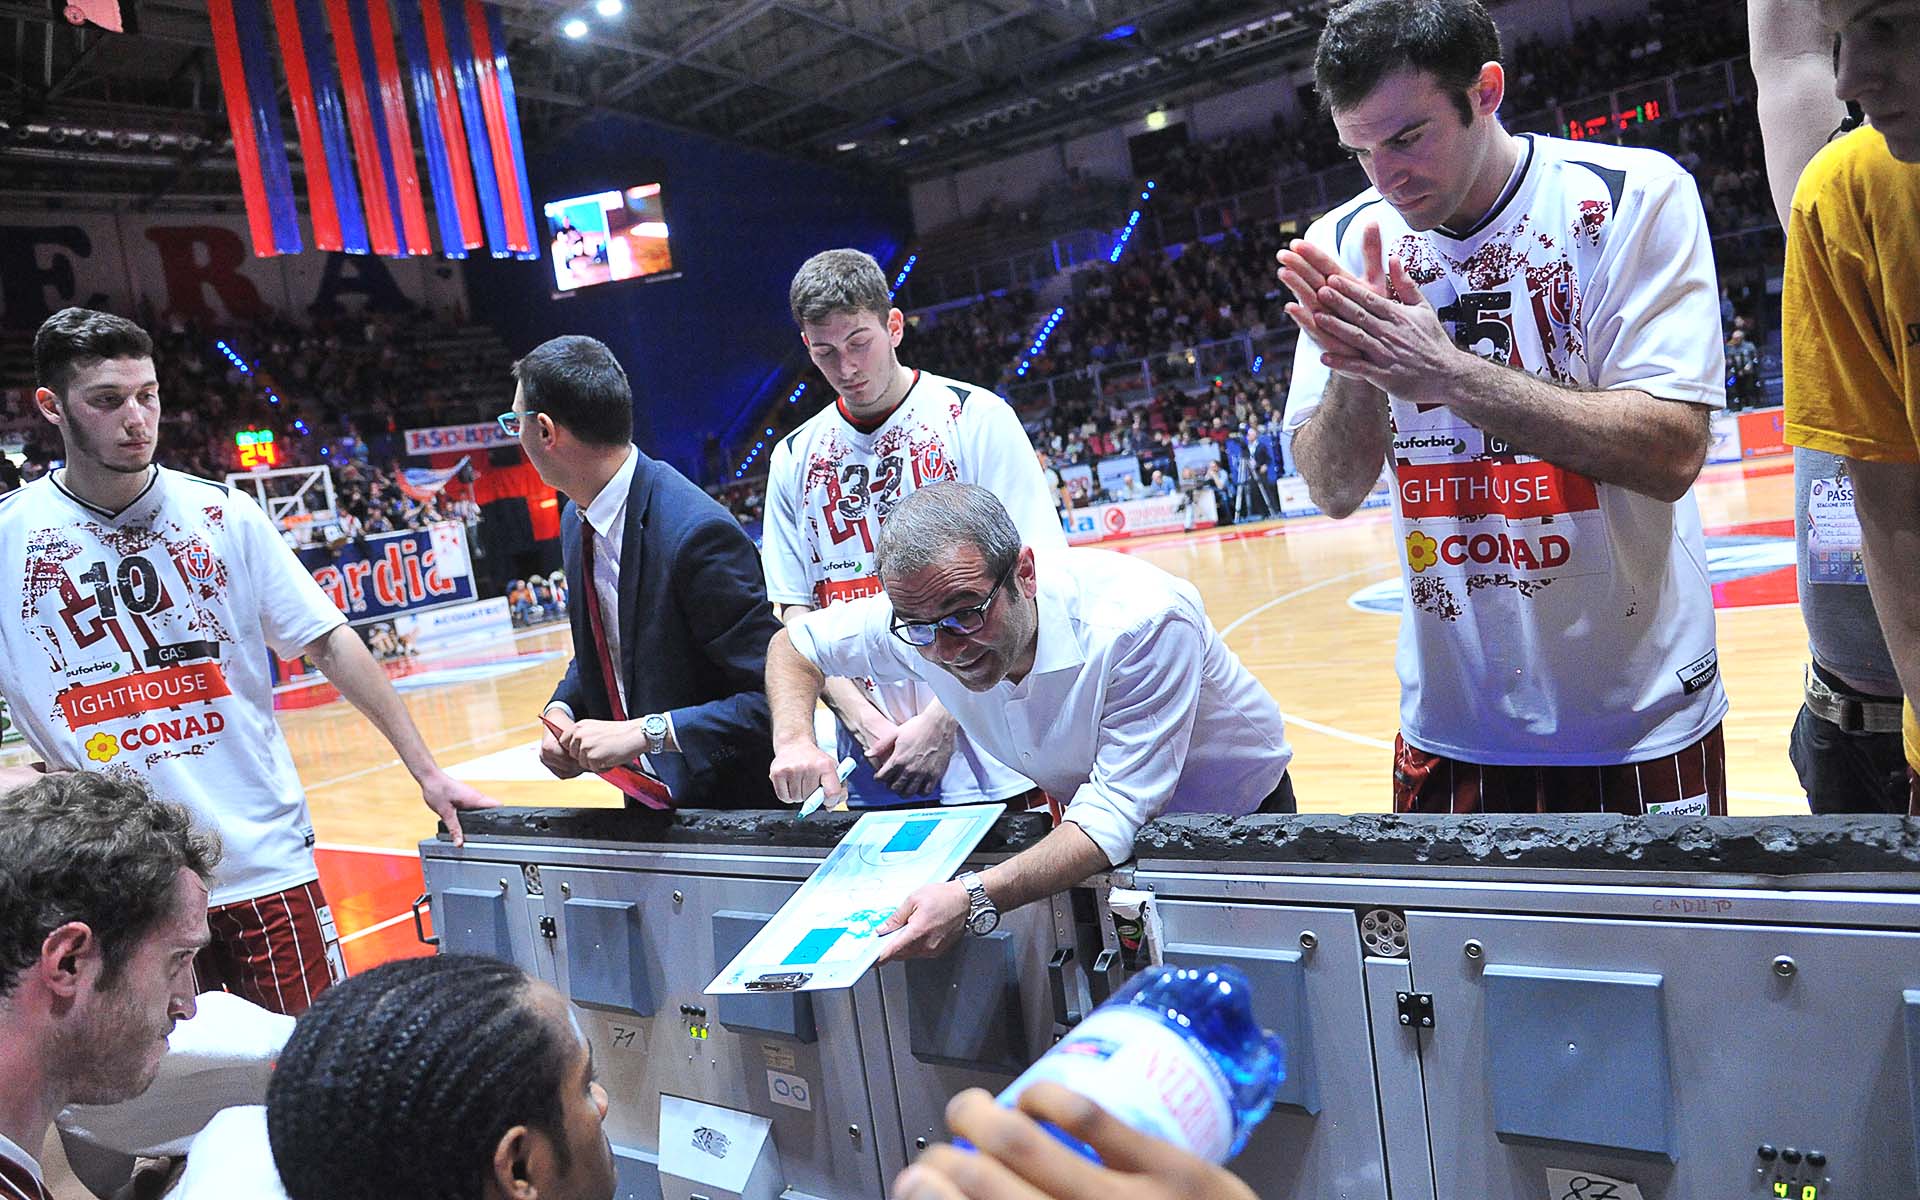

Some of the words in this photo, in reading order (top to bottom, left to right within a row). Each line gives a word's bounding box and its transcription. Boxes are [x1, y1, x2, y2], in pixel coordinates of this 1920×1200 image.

[239, 442, 275, 467] 24
[1393, 436, 1456, 450] euforbia
[836, 454, 904, 520] 32
[1827, 490, 1854, 502] PASS
[1440, 532, 1571, 570] CONAD
[79, 553, 161, 620] 10
[66, 661, 112, 677] euforbia
[158, 646, 188, 661] GAS
[71, 673, 208, 717] IGHTHOUSE
[120, 711, 225, 752] CONAD
